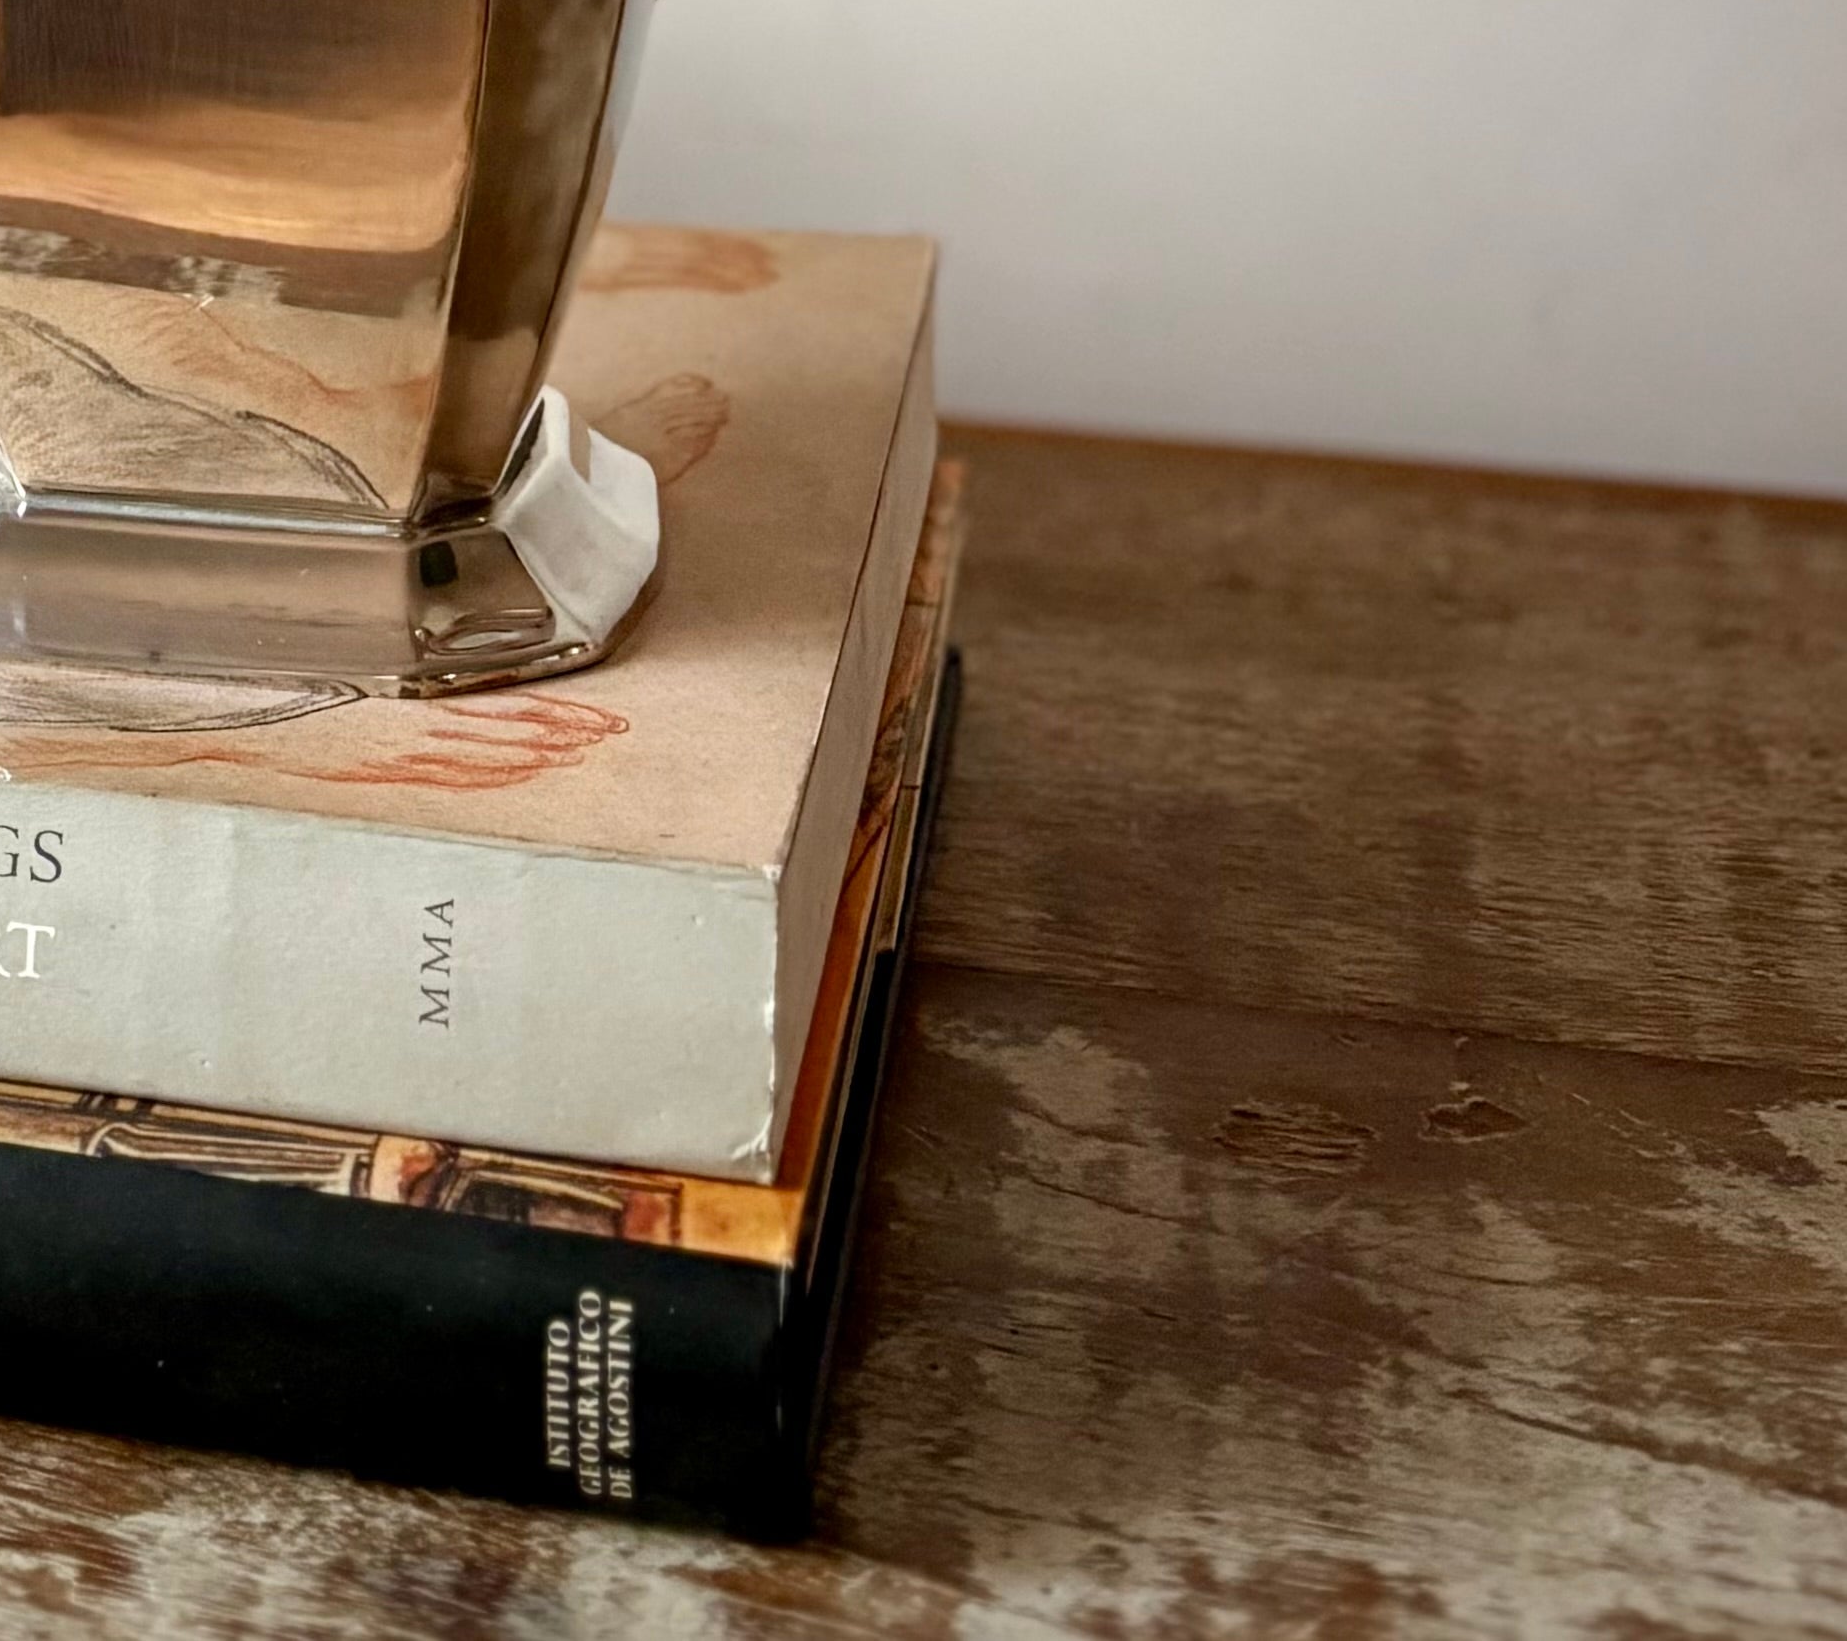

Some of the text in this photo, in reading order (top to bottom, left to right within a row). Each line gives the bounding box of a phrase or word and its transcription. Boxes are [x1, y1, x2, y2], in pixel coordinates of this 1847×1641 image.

[547, 1320, 570, 1467] ISTITUTO
[577, 1291, 601, 1495] GEOGRAFICO
[607, 1300, 632, 1498] DE AGOSTINI
